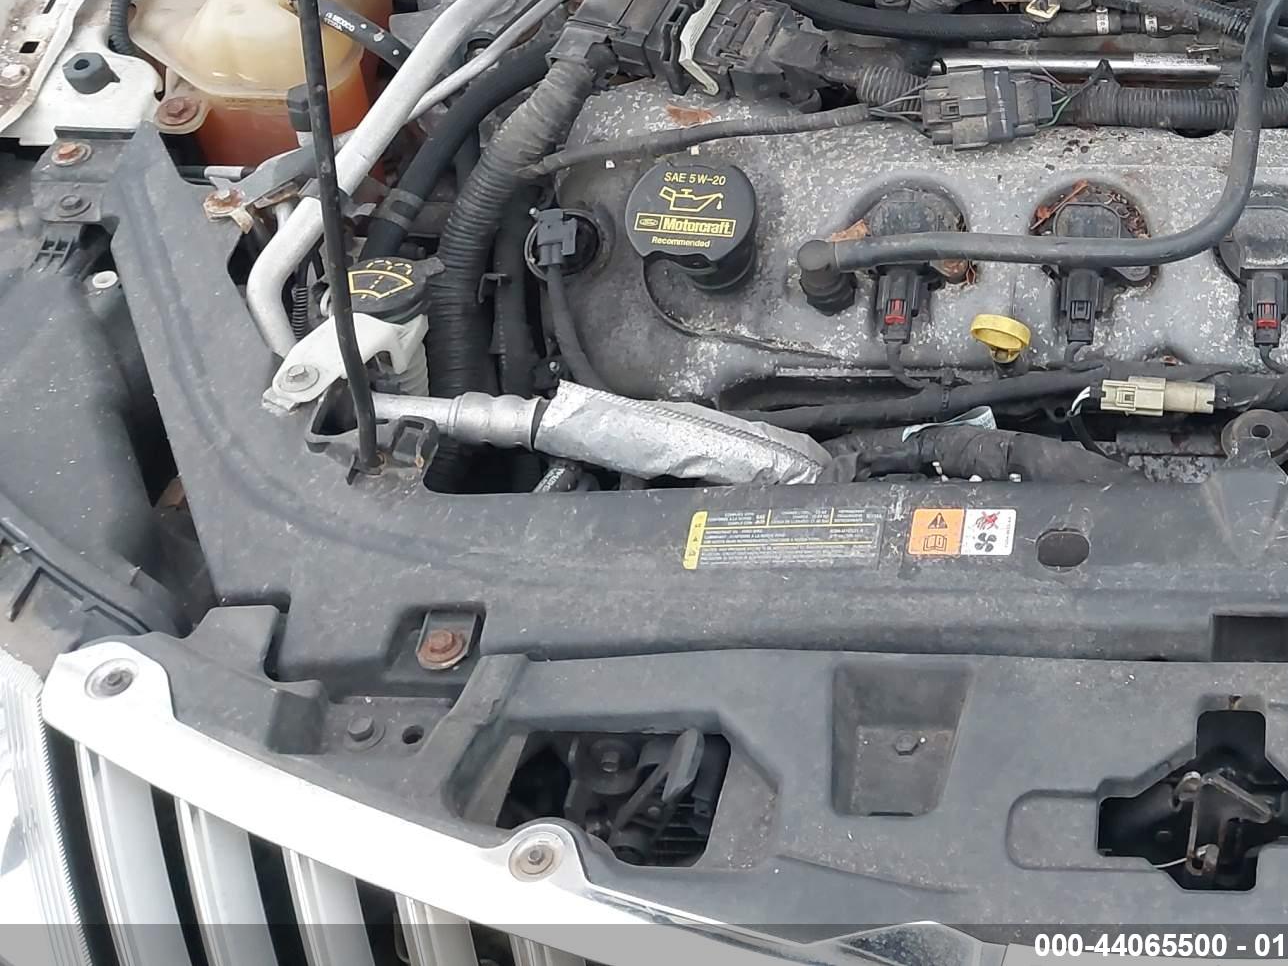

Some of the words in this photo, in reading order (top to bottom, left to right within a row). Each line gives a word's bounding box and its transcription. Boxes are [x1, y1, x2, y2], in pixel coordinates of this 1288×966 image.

[664, 172, 687, 183] SAE
[689, 174, 726, 186] 5W-20
[662, 217, 732, 235] Motorcraft
[651, 236, 711, 248] Recommended
